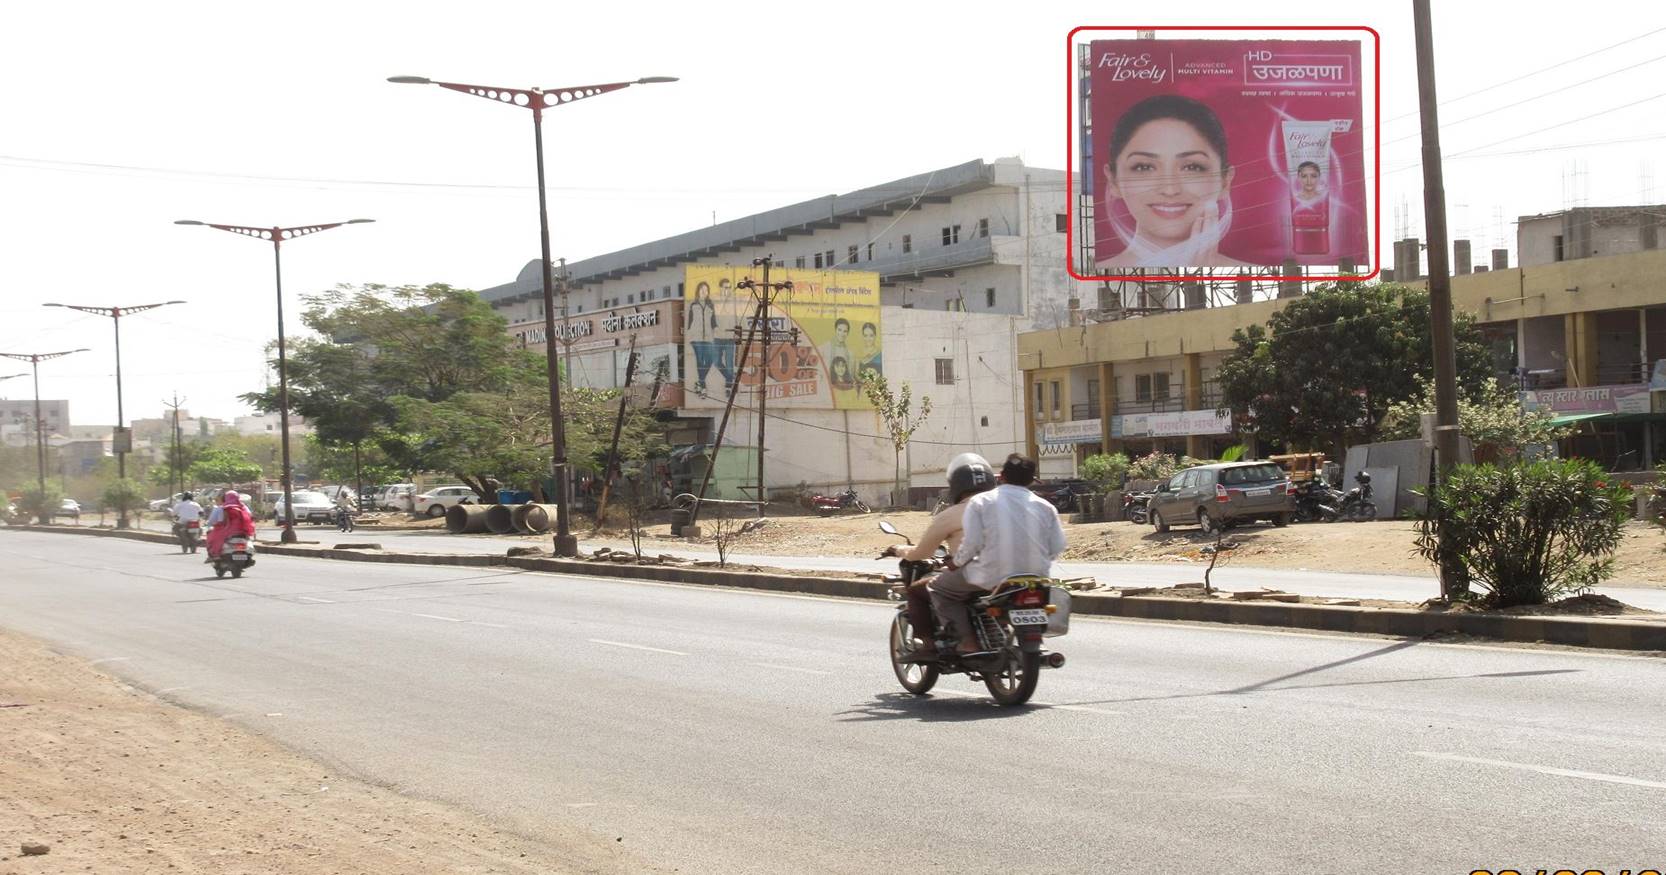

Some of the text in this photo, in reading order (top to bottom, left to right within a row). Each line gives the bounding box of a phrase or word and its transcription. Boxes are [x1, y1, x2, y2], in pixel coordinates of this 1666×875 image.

[1098, 52, 1151, 68] Fair &
[1248, 50, 1272, 61] HD
[1112, 65, 1166, 83] Lovely
[1252, 65, 1343, 81] उजळपणा
[789, 383, 815, 396] SALE
